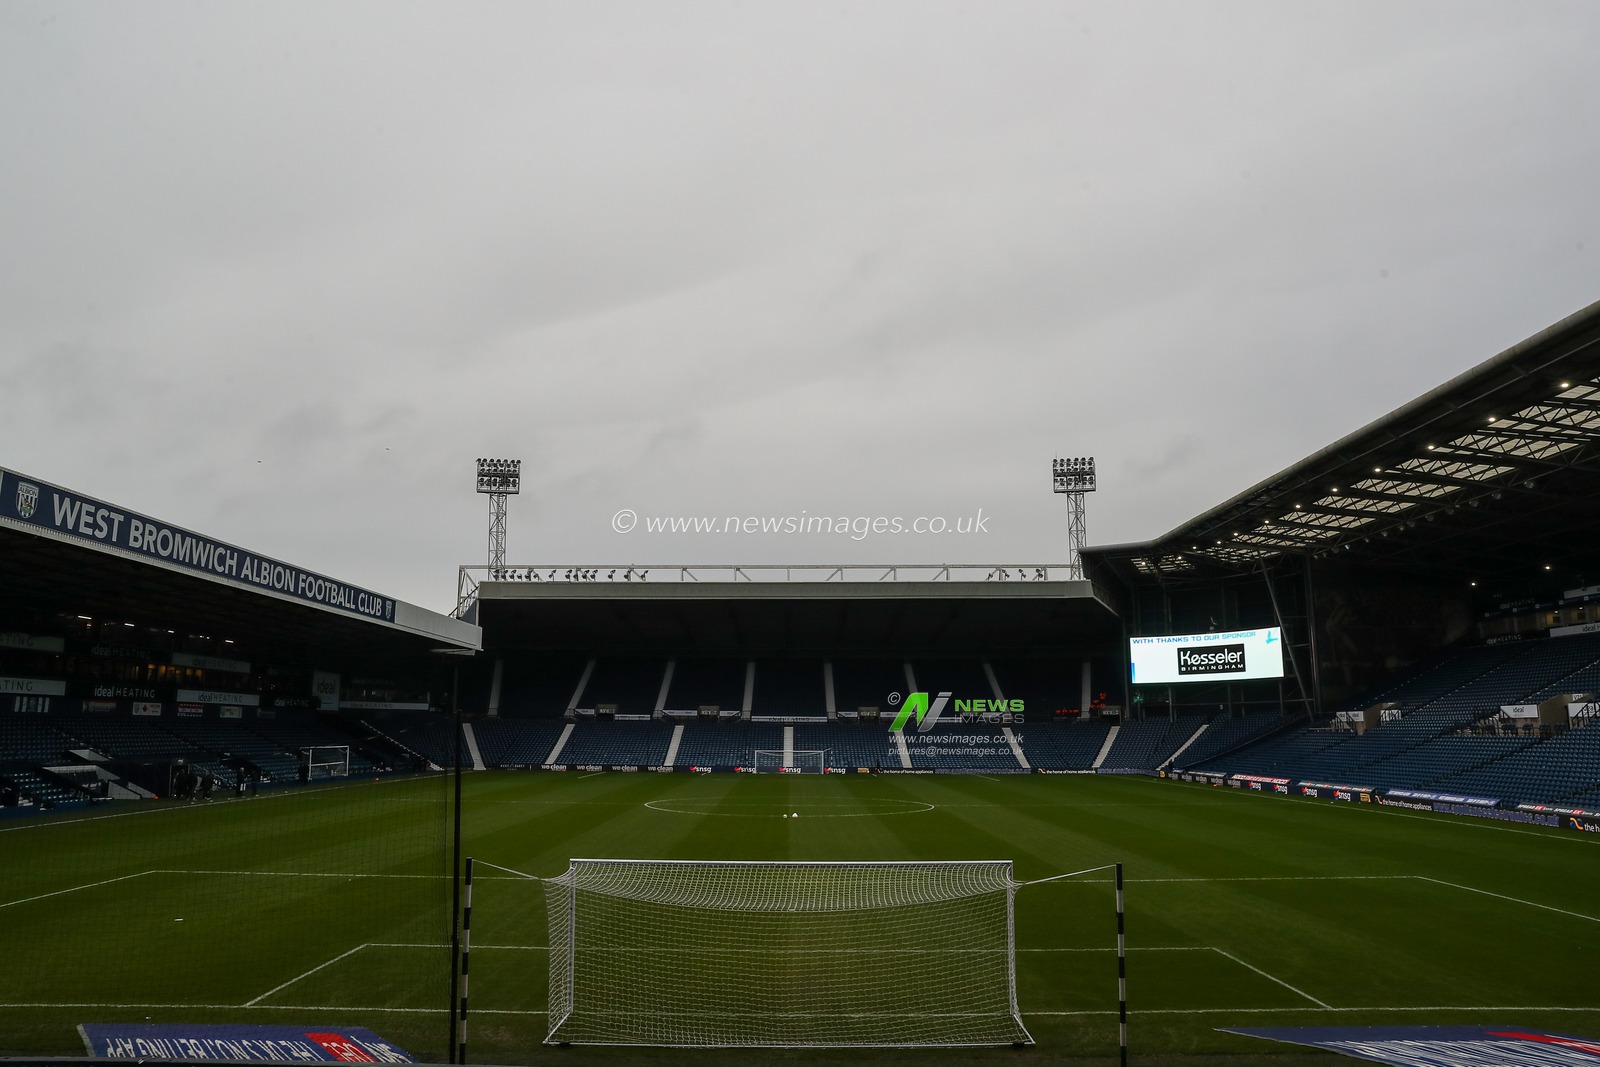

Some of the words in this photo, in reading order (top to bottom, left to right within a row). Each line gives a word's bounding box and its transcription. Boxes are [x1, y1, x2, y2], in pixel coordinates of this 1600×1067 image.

[53, 493, 125, 542] WEST
[128, 518, 238, 576] BROMWICH
[240, 556, 296, 593] ALBION
[298, 573, 356, 610] FOOTBALL
[357, 592, 382, 616] CLUB
[1222, 631, 1256, 639] SPONSOR
[1180, 648, 1243, 666] Kesseler
[1181, 663, 1244, 672] BIRMINGHAM
[0, 680, 33, 692] TING
[94, 685, 115, 697] ideal
[116, 687, 156, 699] HEATING
[317, 679, 336, 695] ideal
[1584, 823, 1595, 833] the
